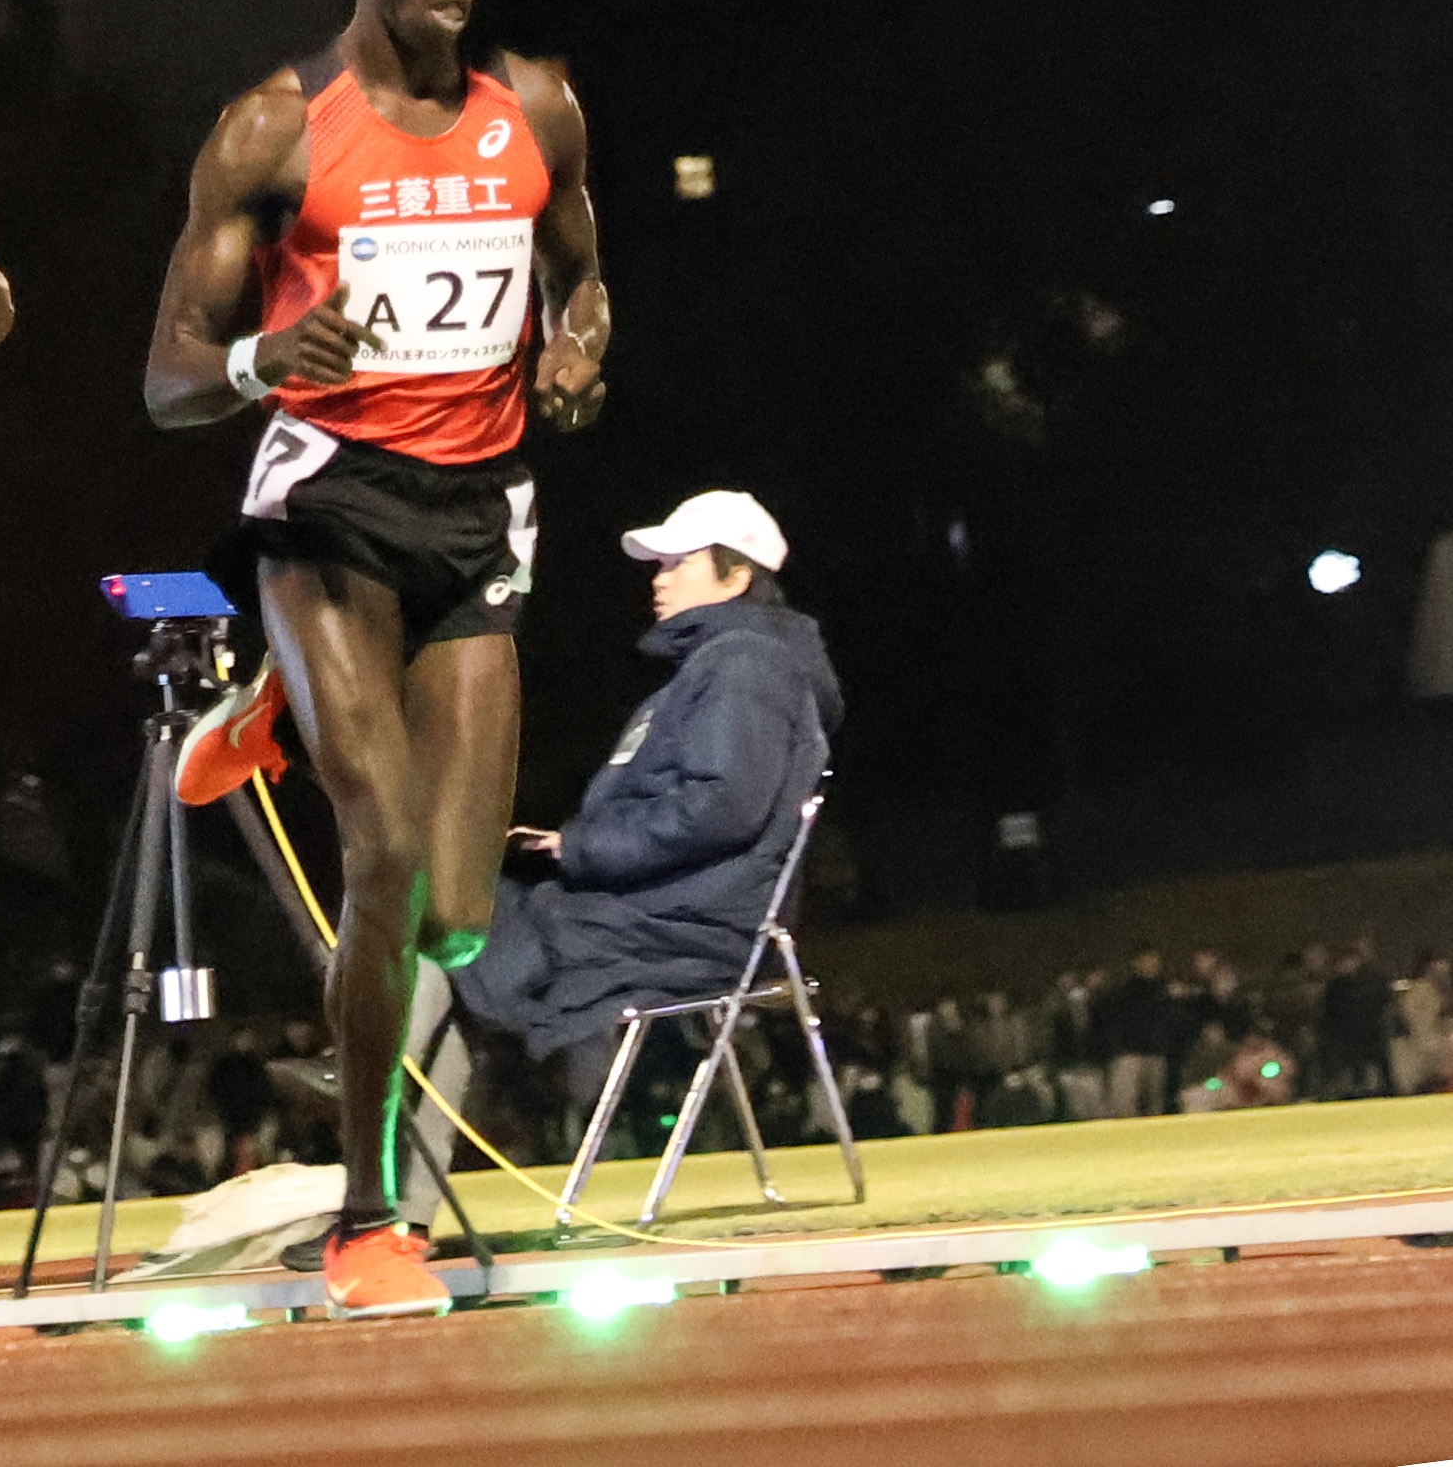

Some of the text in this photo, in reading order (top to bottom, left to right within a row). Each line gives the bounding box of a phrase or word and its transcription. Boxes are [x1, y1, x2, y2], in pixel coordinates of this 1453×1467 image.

[359, 175, 512, 219] 三菱重工
[385, 233, 525, 256] KONICA MINOLTA
[365, 267, 514, 332] A 27
